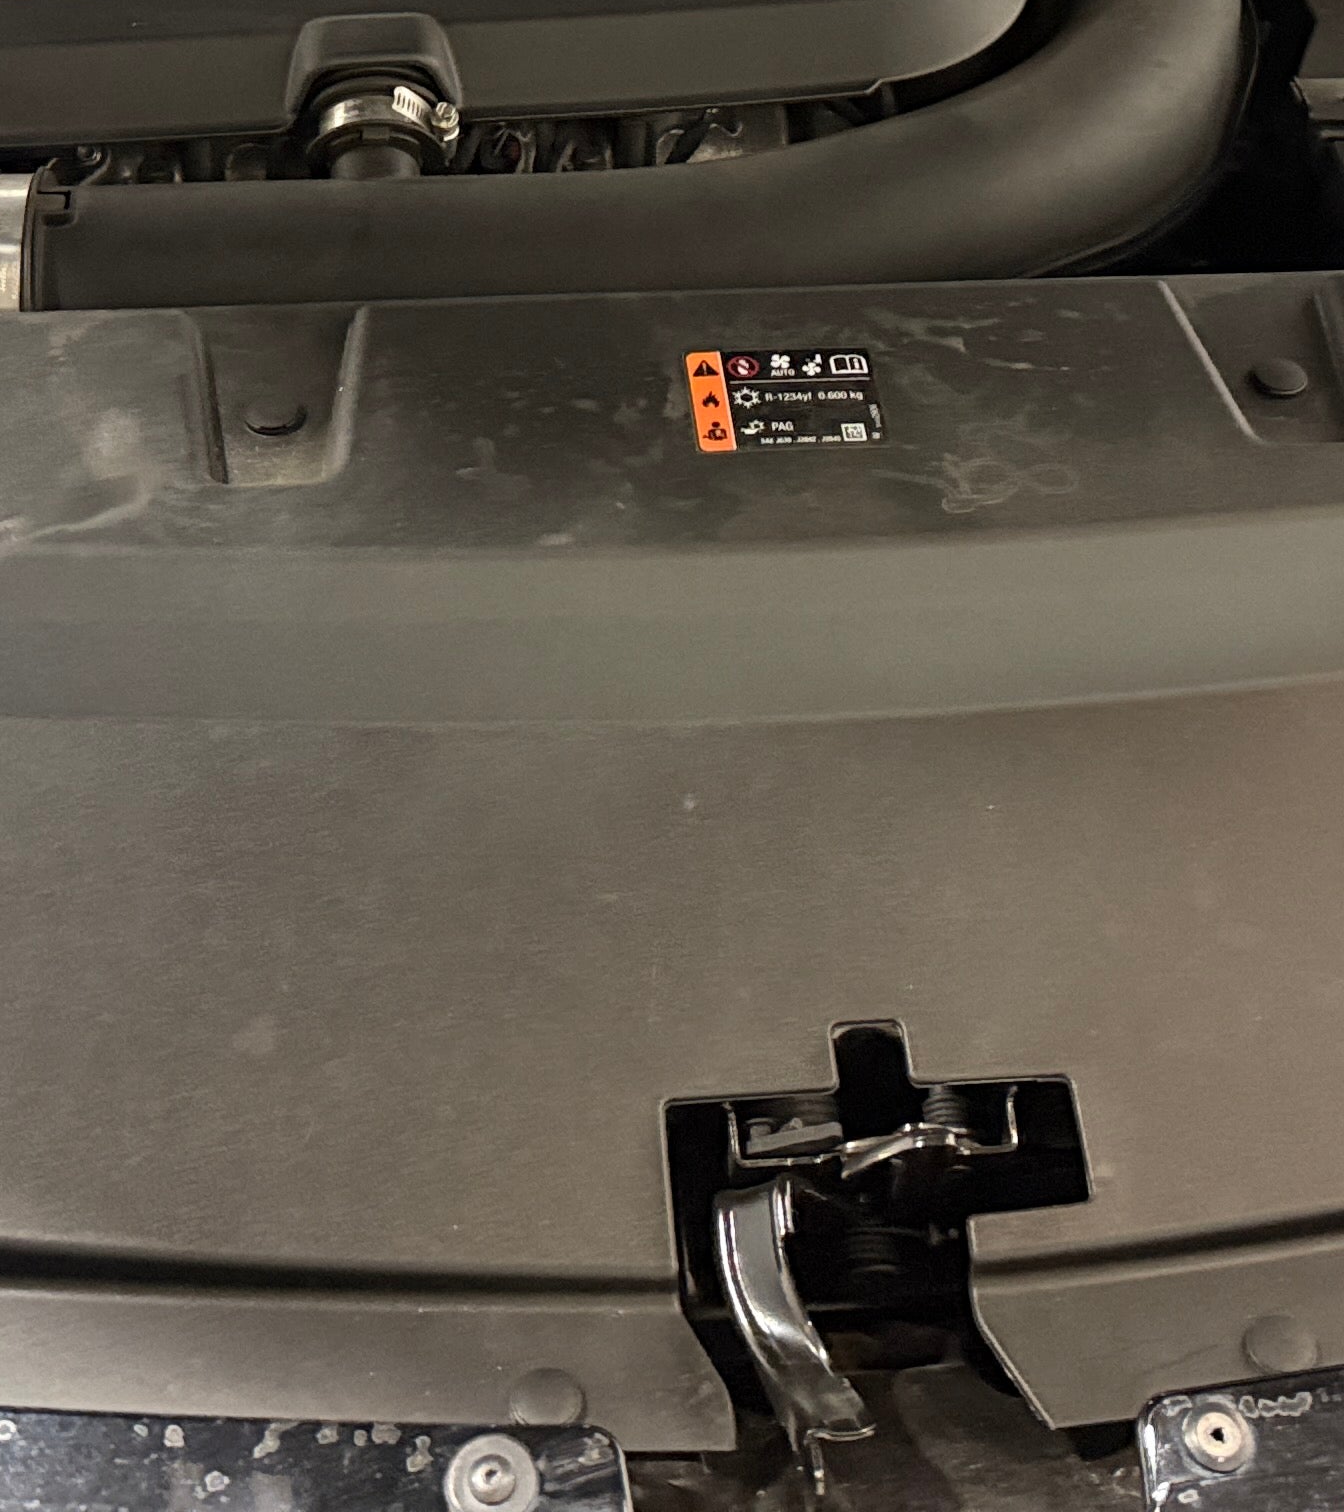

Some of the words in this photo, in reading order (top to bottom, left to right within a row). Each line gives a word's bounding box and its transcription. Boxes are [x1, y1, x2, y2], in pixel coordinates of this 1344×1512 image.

[770, 368, 795, 377] AUTO
[849, 390, 863, 401] kg
[771, 421, 794, 431] PAG
